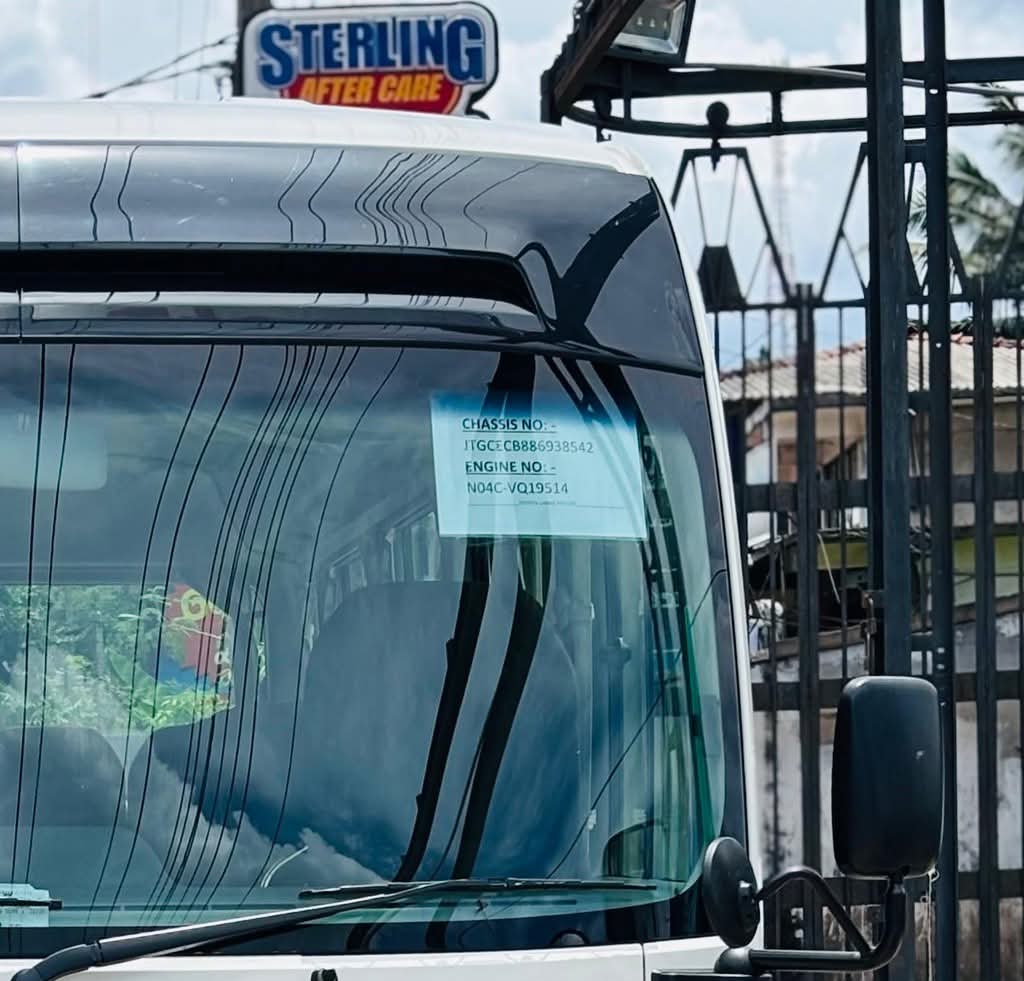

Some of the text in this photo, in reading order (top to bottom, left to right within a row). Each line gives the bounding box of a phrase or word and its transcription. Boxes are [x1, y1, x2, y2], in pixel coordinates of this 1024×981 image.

[259, 17, 486, 87] STERLING
[299, 73, 445, 104] AFTER CARE
[462, 418, 518, 430] CHASSIS
[465, 461, 518, 473] ENGINE
[467, 481, 568, 495] N04C-VQ19514
